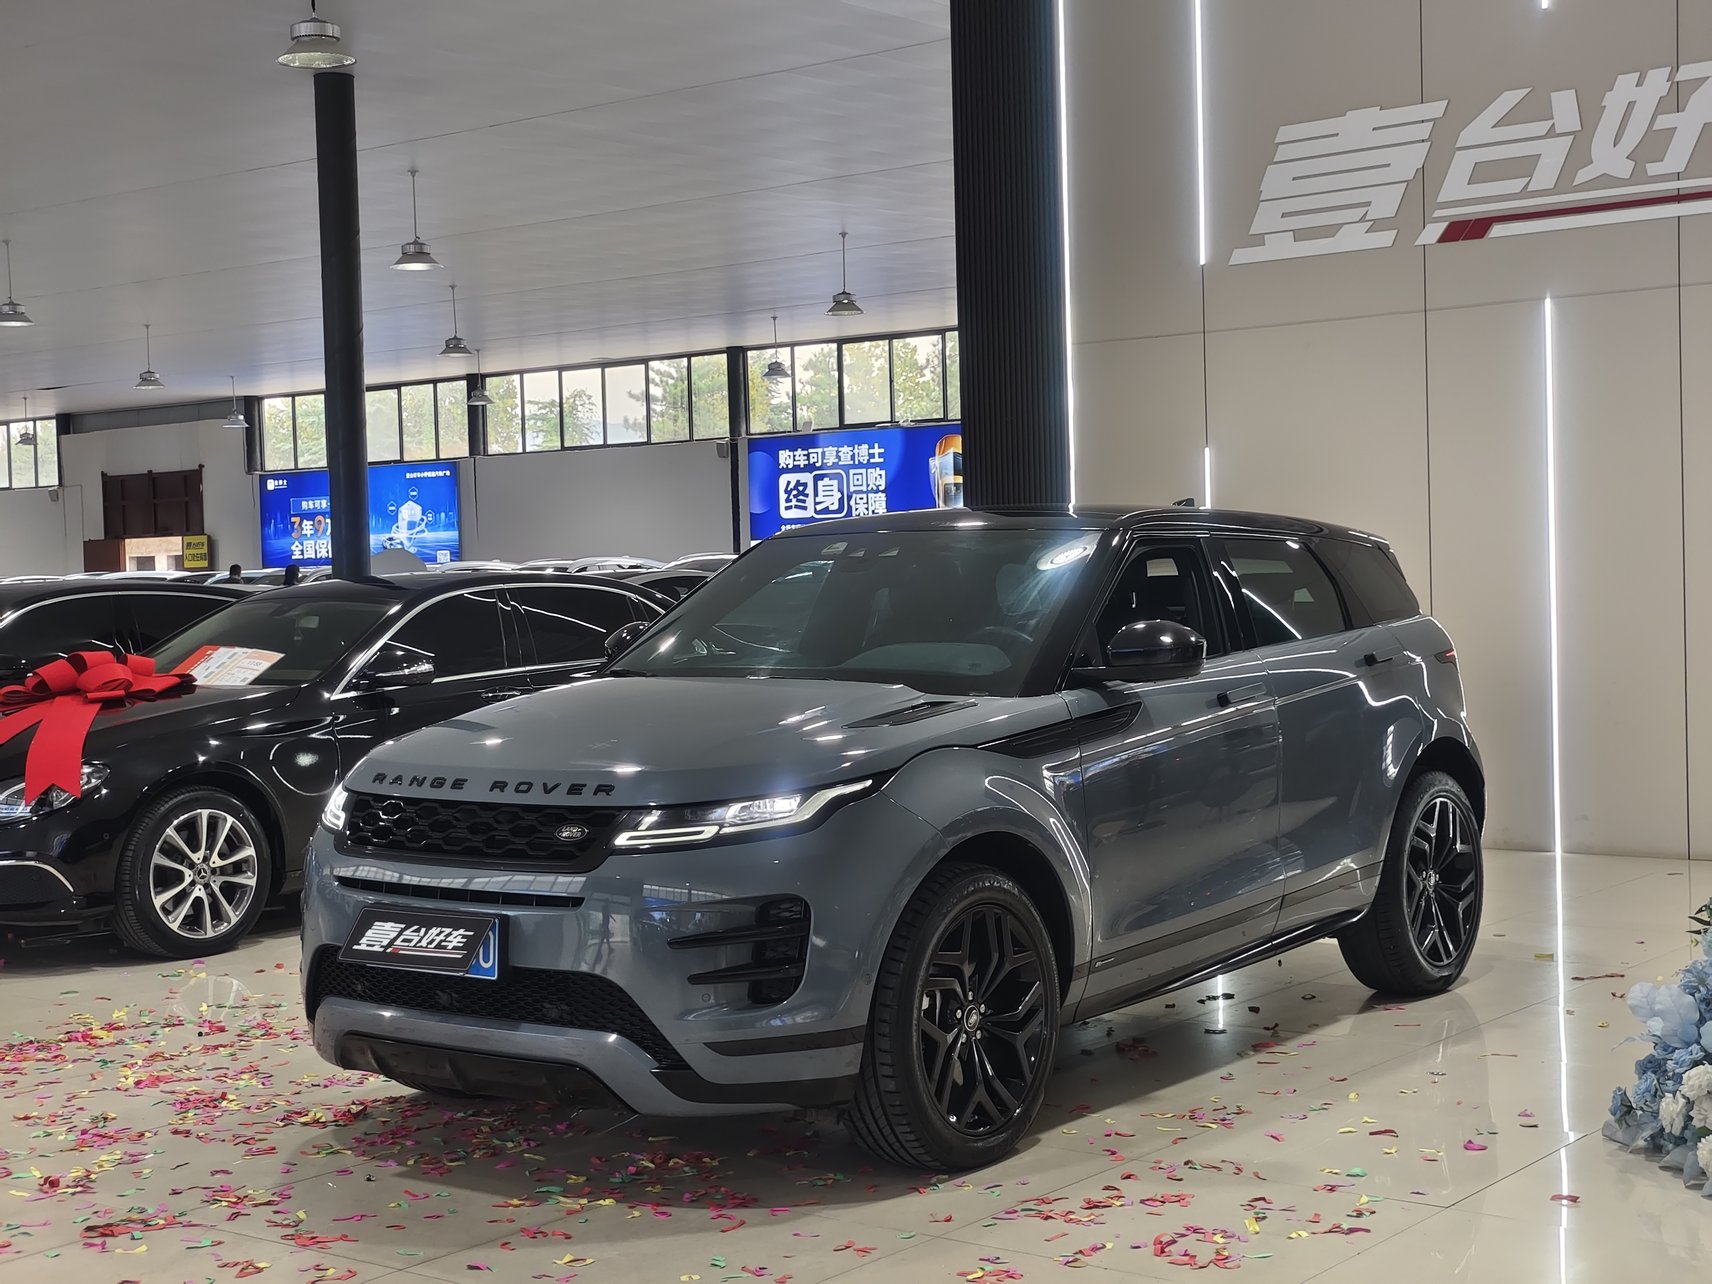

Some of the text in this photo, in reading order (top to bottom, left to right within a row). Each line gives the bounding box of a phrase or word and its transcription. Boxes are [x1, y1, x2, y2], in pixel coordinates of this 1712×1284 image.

[779, 443, 885, 469] 购车可享查博士
[850, 467, 886, 492] 回购
[301, 499, 330, 510] 购车可享
[783, 477, 842, 512] 终身
[850, 493, 887, 516] 保障
[290, 540, 332, 559] 全国保
[372, 772, 616, 797] RANGE ROVER
[352, 921, 474, 952] 壹台好车
